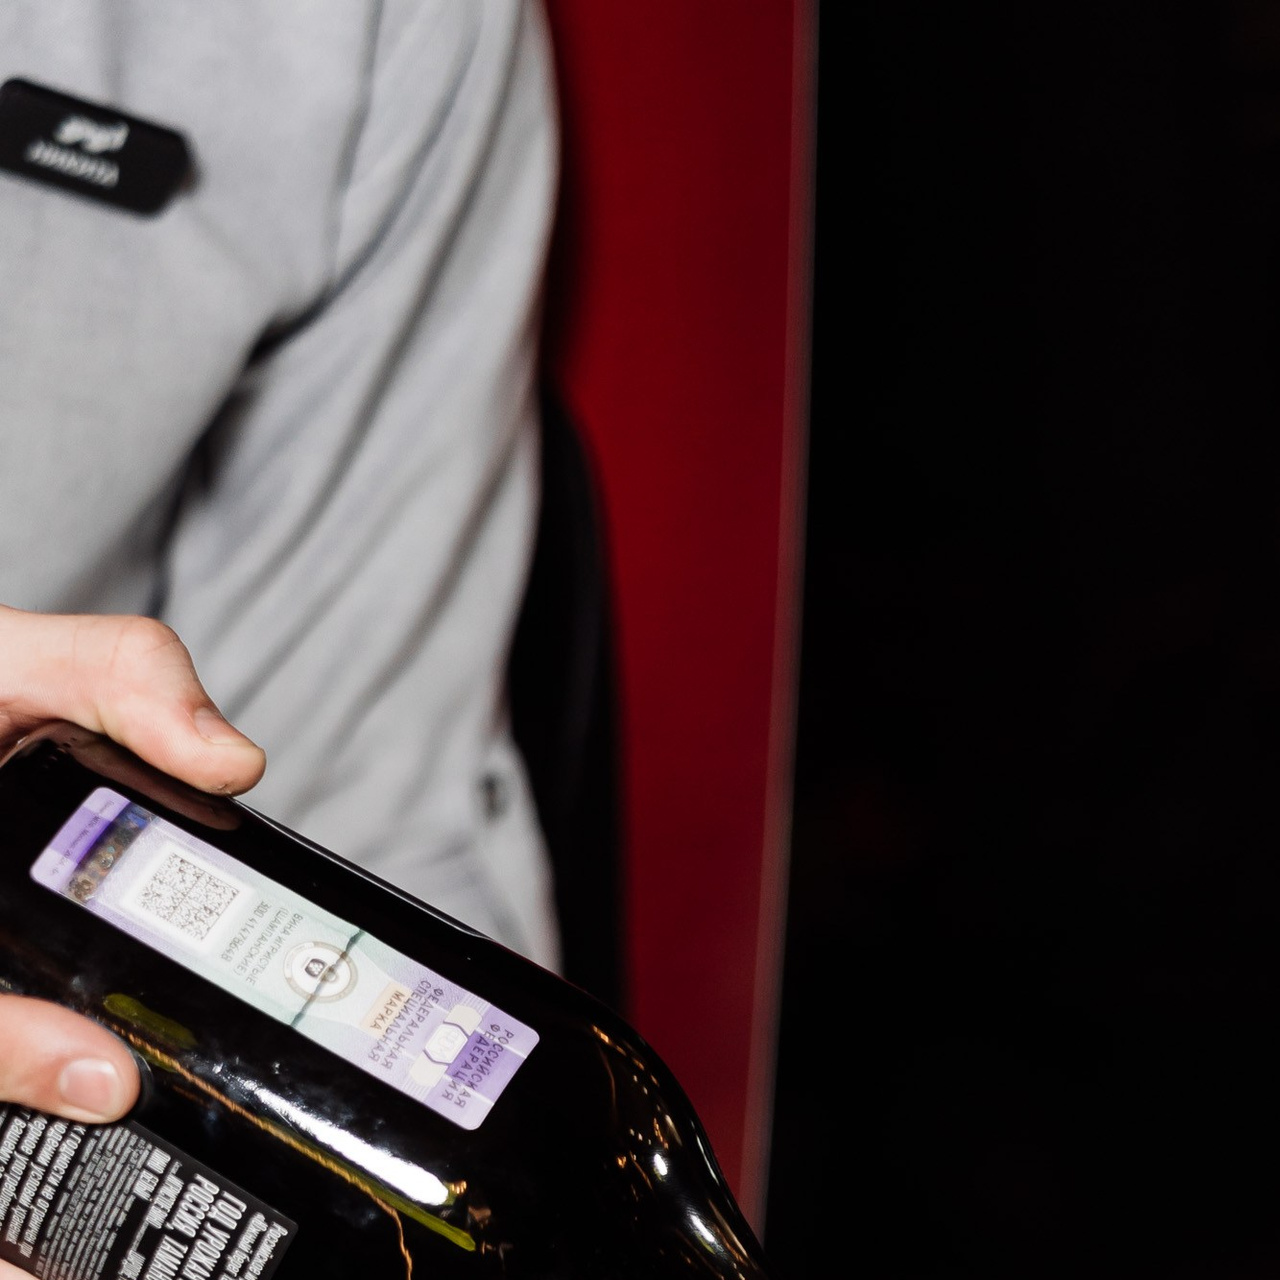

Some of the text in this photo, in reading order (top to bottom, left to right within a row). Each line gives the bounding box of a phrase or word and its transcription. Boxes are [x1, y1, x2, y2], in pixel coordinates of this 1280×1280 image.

[231, 905, 290, 977] (ШАМПАНСКИЕ)
[244, 912, 304, 986] ВИНА ИГРИСТЫЕ
[366, 978, 432, 1063] СПЕЦИАЛЬНАЯ
[369, 989, 406, 1033] МАРКА
[380, 985, 445, 1071] ФЕДЕРАЛЬНАЯ
[440, 1021, 502, 1102] ФЕДЕРАЦИЯ
[452, 1028, 515, 1109] РОССИЙСКАЯ
[45, 1129, 83, 1187] годности
[144, 1146, 172, 1175] ПИНО
[17, 1161, 46, 1209] условий
[39, 1182, 58, 1202] не
[131, 1167, 162, 1203] БЕЛЫЙ
[152, 1171, 186, 1213] ИГРИСТОЕ
[165, 1172, 221, 1241] РОССИЯ,
[206, 1188, 249, 1231] ГОД
[22, 1195, 51, 1245] ограничен
[143, 1204, 169, 1231] ВИНО
[17, 1239, 34, 1259] при
[220, 1247, 252, 1279] берег
[247, 1221, 290, 1277] Российское
